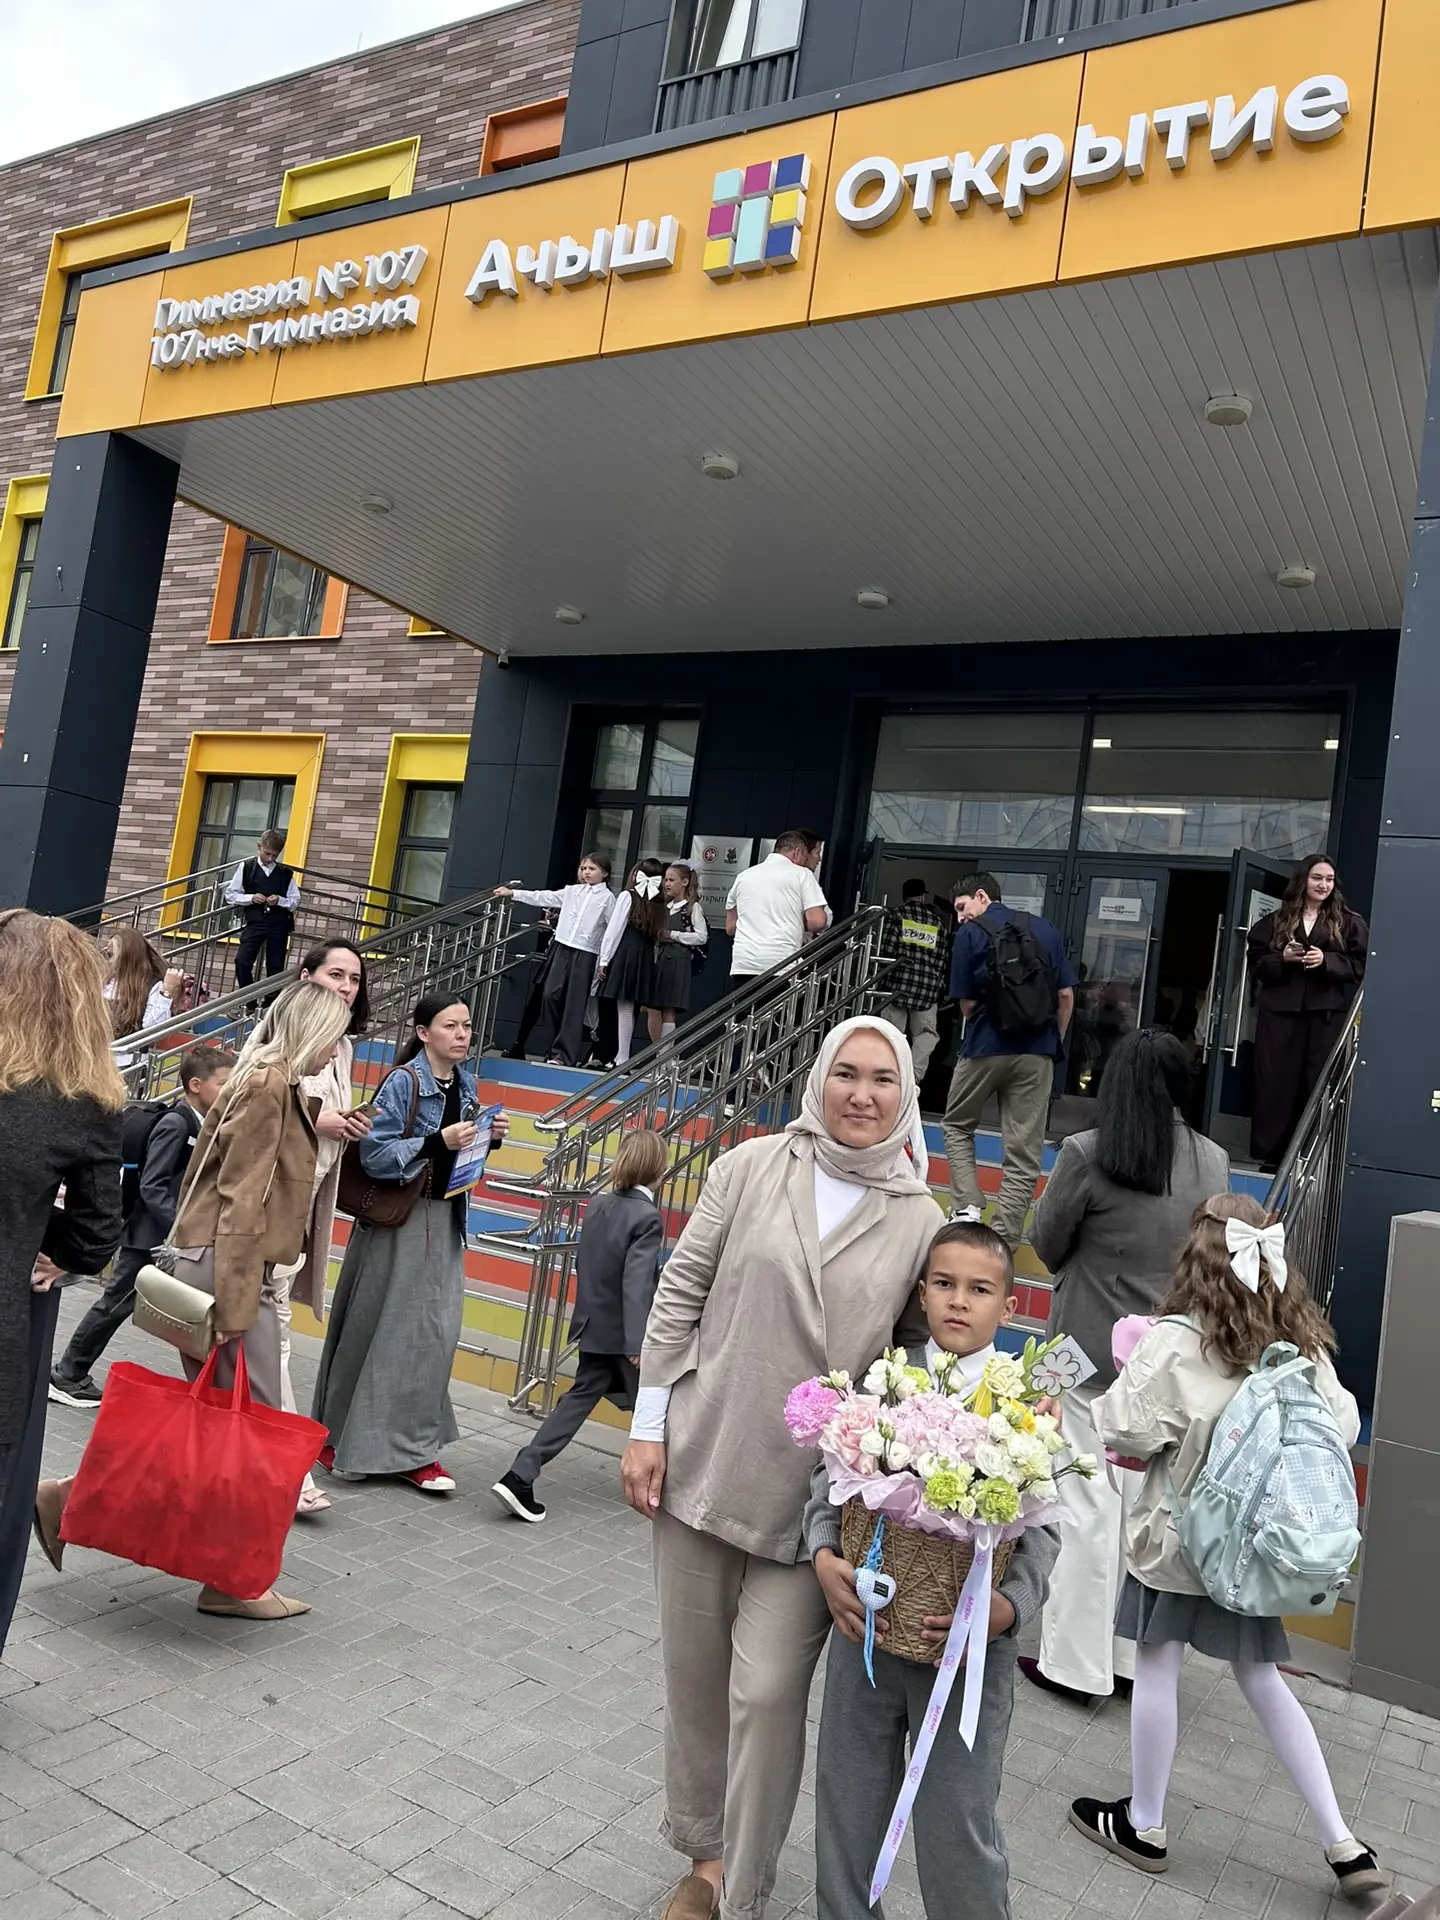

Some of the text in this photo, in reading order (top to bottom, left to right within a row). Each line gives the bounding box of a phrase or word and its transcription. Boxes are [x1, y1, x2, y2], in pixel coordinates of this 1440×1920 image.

[835, 73, 1350, 230] Открытие
[154, 275, 312, 334] Гимназия
[364, 244, 428, 294] 107
[464, 214, 680, 304] Ачыш
